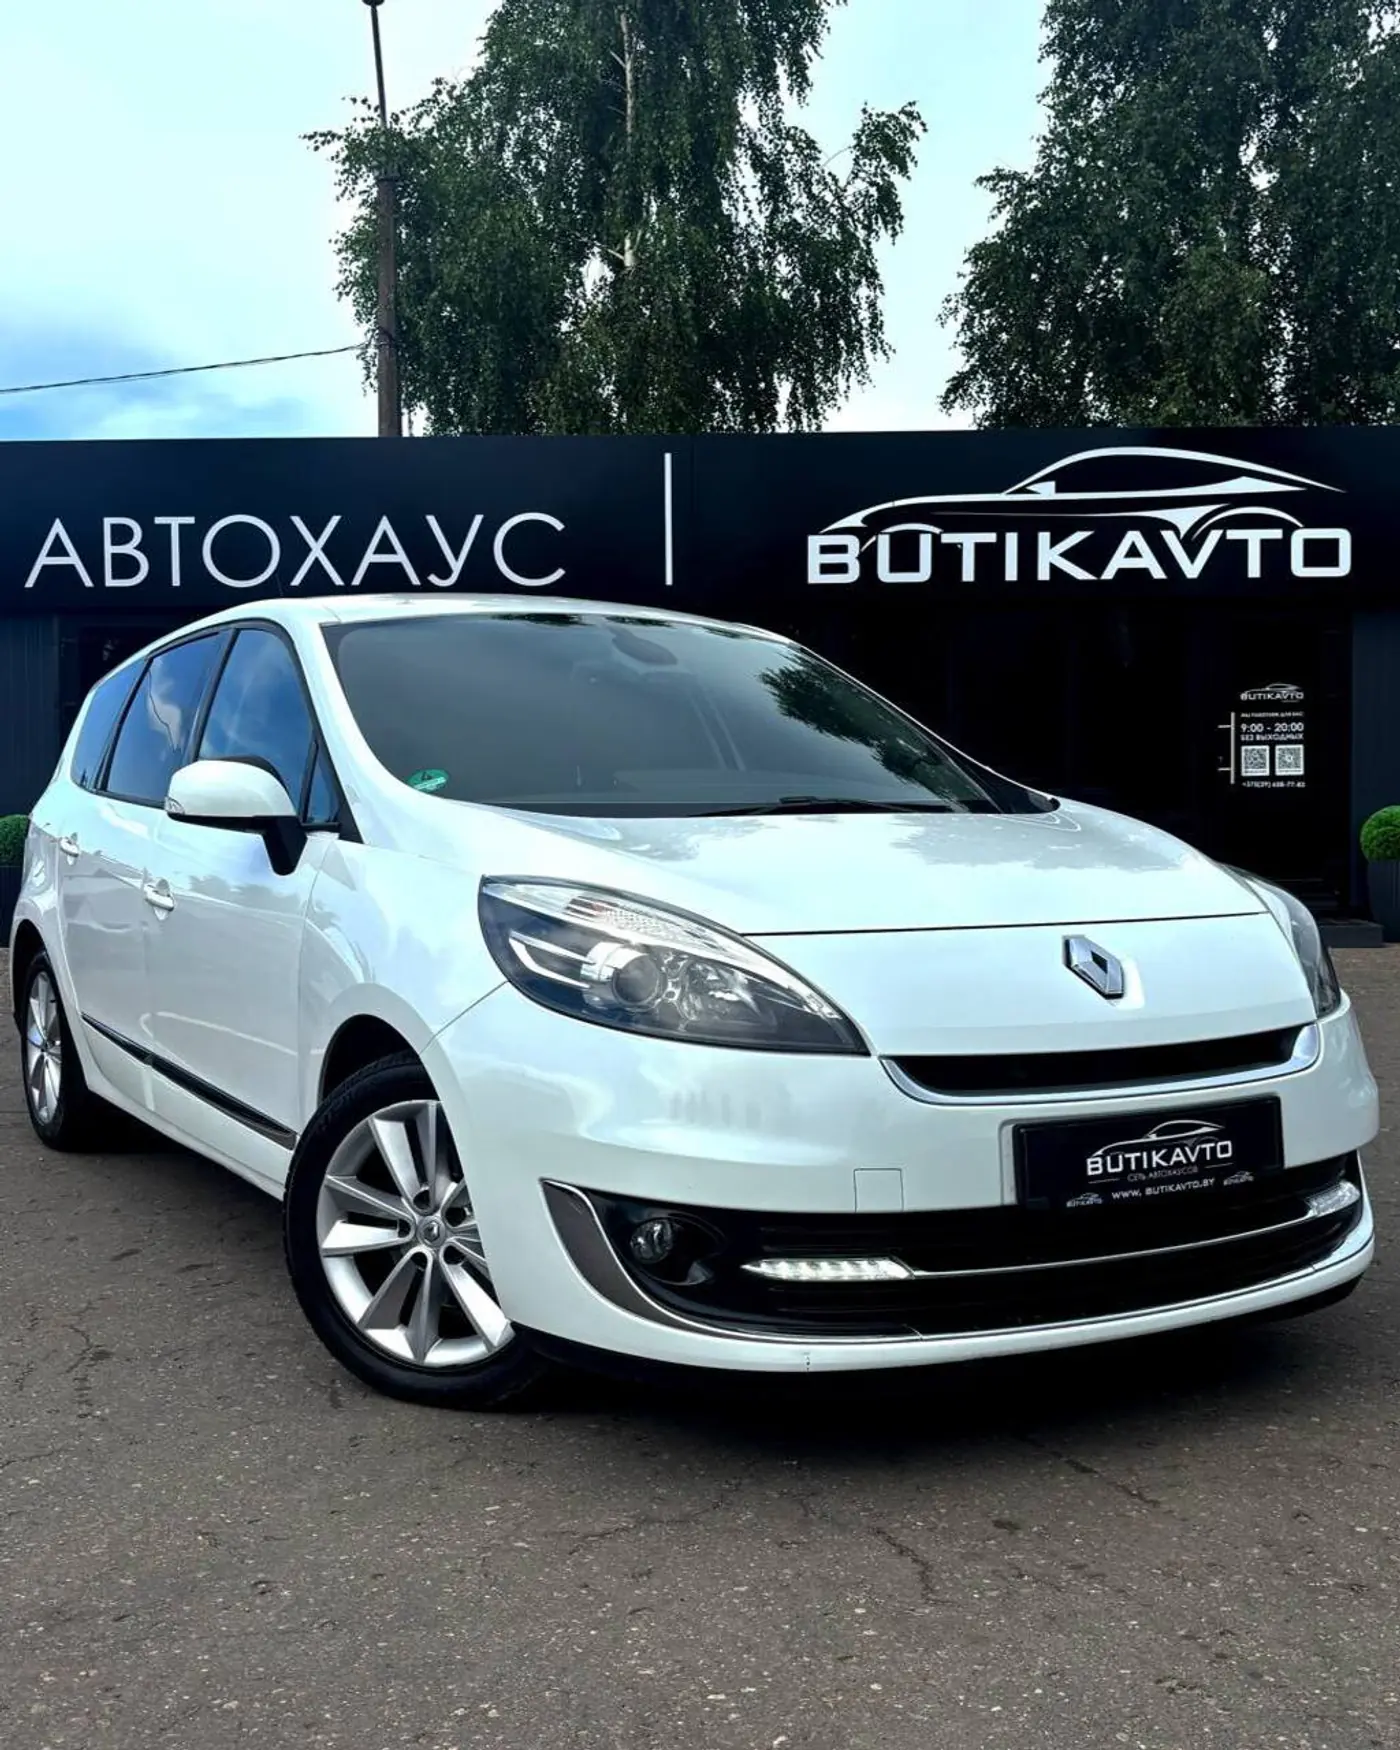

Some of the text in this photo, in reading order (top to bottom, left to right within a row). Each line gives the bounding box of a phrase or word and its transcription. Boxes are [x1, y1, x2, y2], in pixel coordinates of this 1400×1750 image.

[25, 514, 566, 588] АВТОХАУС
[807, 528, 1352, 584] BUTIKAVTO
[1241, 723, 1263, 732] 9:00
[1274, 722, 1304, 731] 20:00
[1086, 1141, 1232, 1175] BUTIKAVTO
